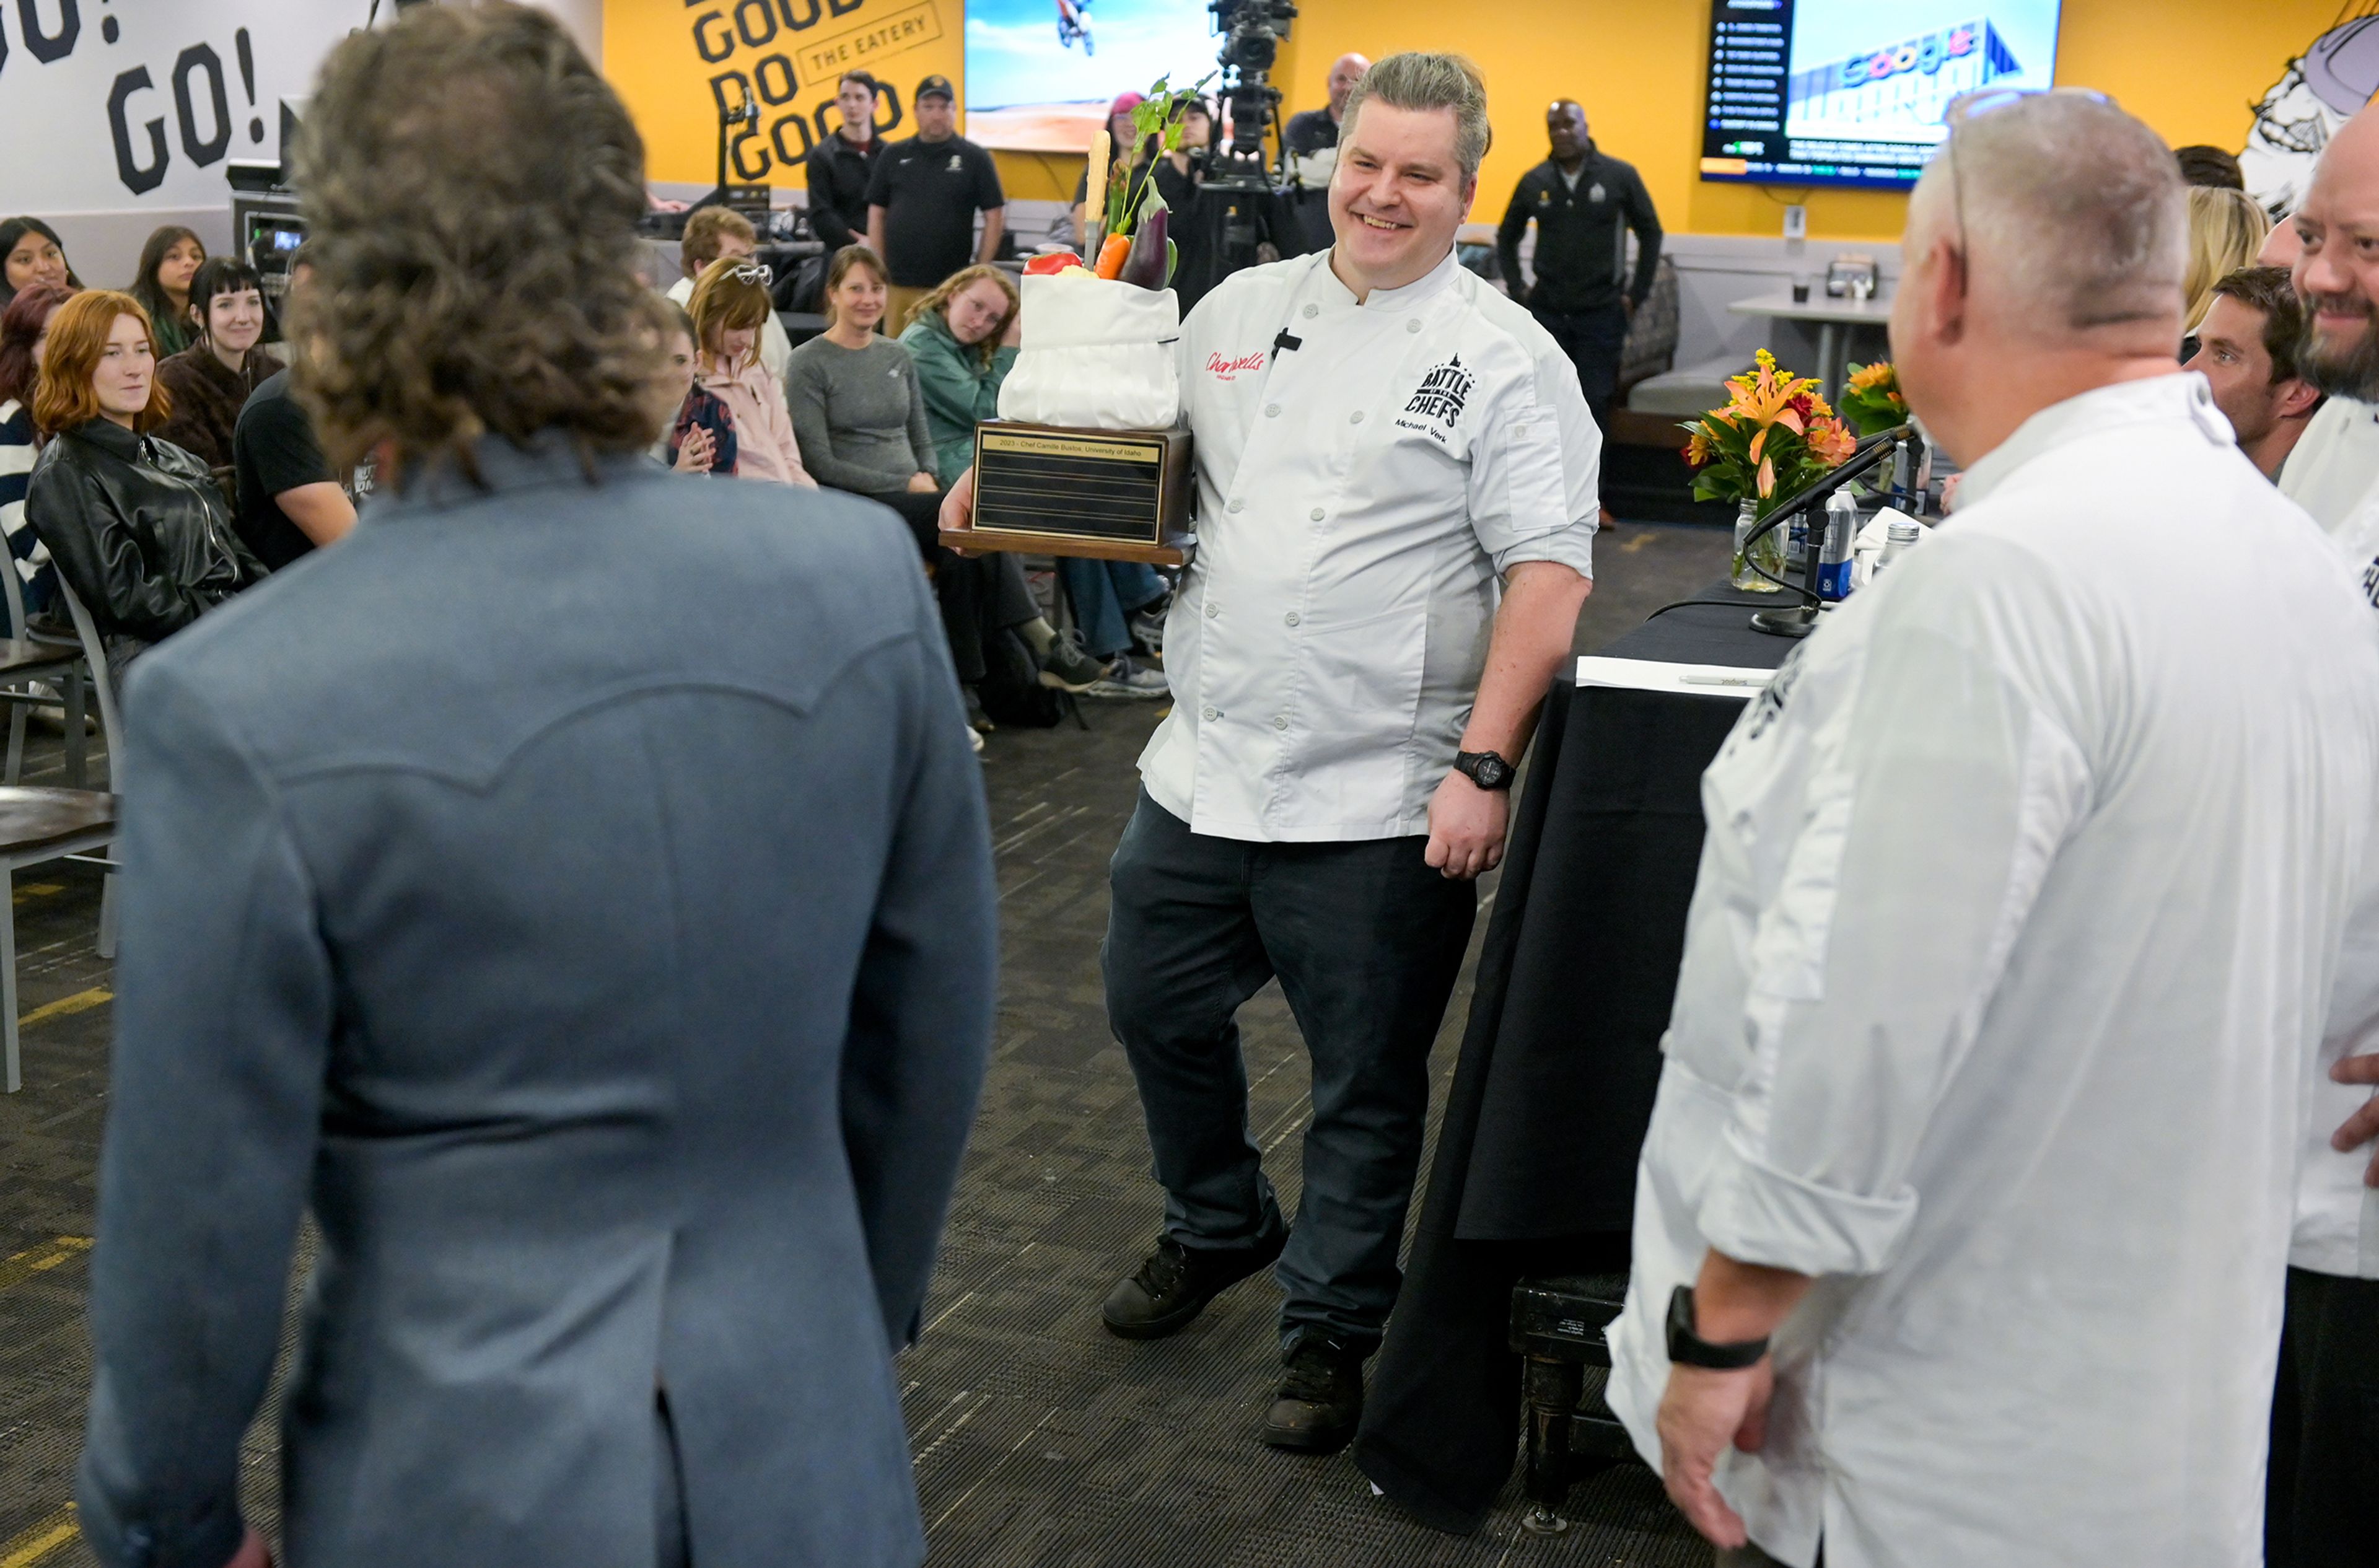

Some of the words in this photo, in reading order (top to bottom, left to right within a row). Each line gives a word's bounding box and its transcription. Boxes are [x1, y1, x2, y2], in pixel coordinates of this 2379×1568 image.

[811, 43, 849, 71] THE
[854, 15, 926, 55] EATERY
[1839, 28, 1978, 89] Google
[709, 53, 798, 124] DO
[107, 27, 264, 195] GO!
[1421, 368, 1472, 401] BATTLE
[1395, 419, 1427, 431] Michael
[1404, 395, 1460, 428] CHEFS
[1036, 442, 1059, 450] Camille
[1085, 445, 1115, 455] University
